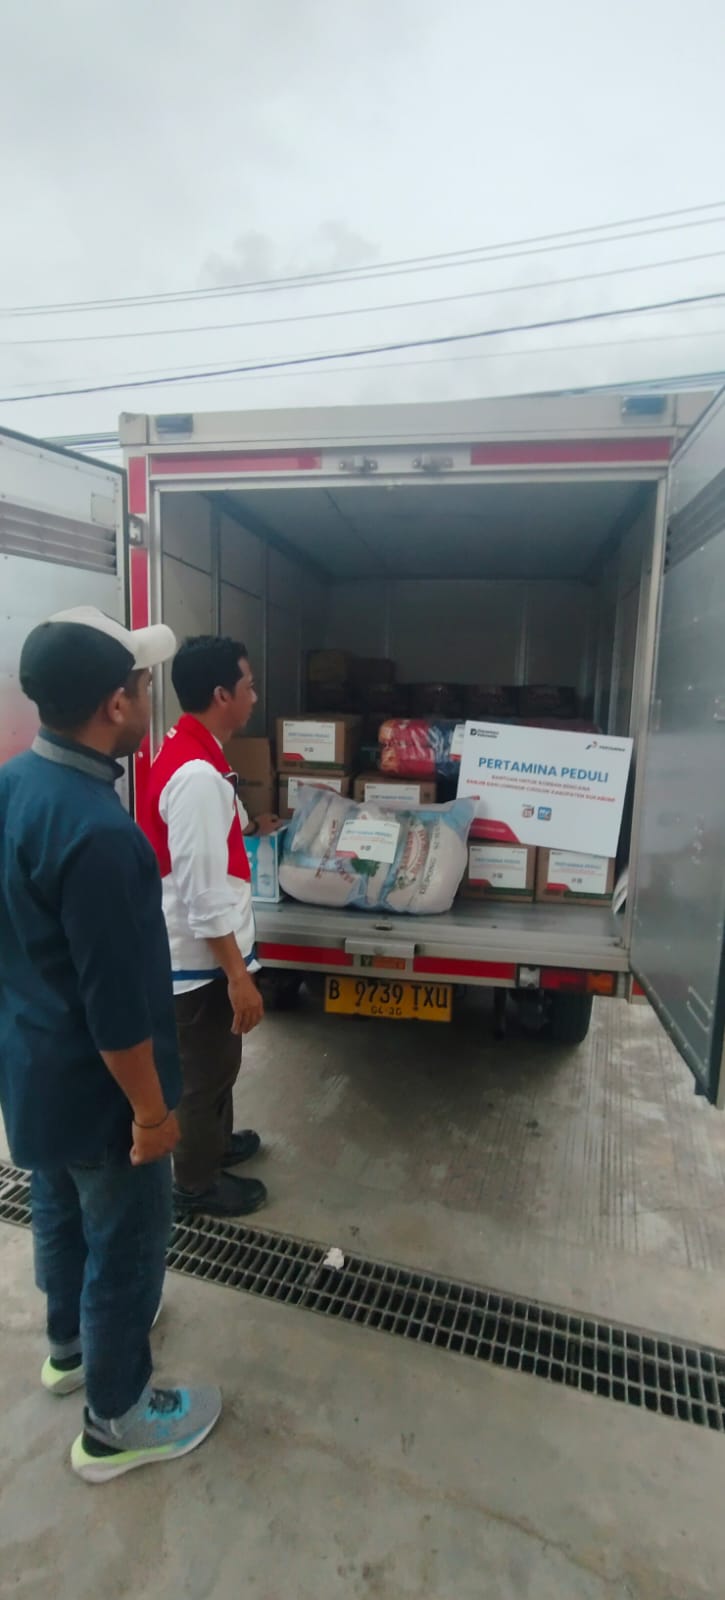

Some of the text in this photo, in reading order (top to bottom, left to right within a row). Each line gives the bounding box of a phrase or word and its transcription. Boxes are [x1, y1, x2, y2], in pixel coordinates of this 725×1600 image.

[478, 757, 608, 783] PERTAMINA PEDULI
[328, 979, 448, 1010] B 9739 TXU
